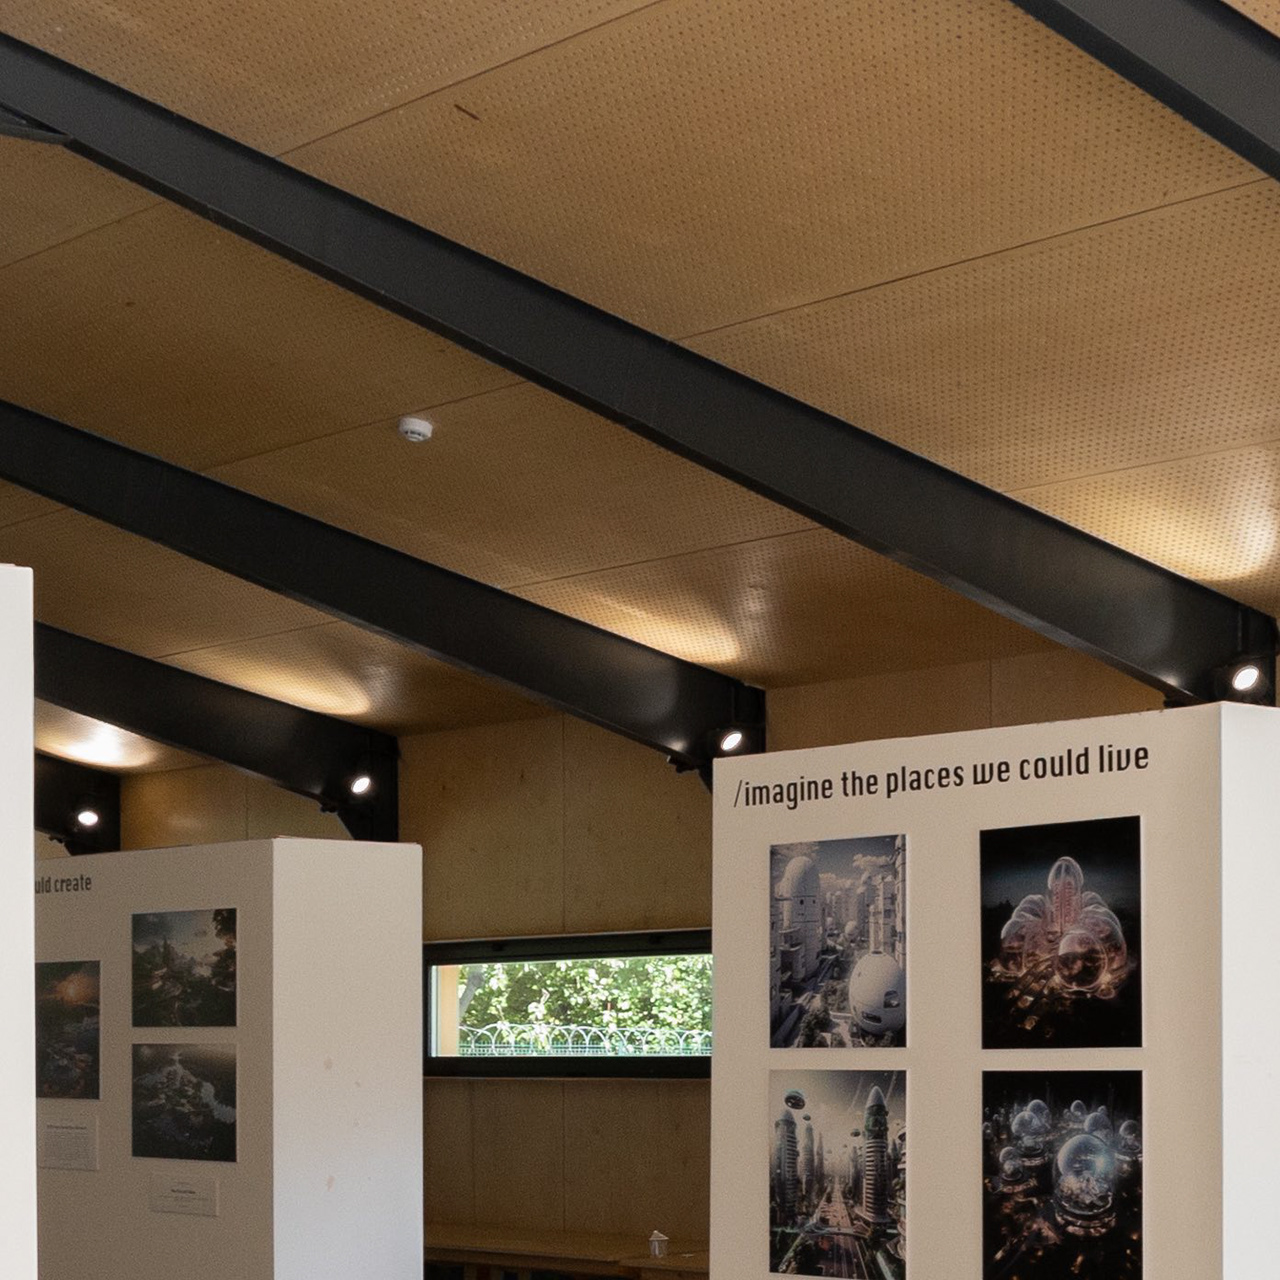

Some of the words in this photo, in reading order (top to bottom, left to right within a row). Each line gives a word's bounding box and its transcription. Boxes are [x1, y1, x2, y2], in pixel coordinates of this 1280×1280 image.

[734, 776, 833, 810] /imagine
[841, 771, 878, 797] the
[887, 766, 964, 798] places
[973, 761, 1010, 785] we
[1019, 747, 1089, 780] could
[1099, 744, 1149, 773] live
[35, 876, 52, 894] uld
[54, 874, 92, 892] create
